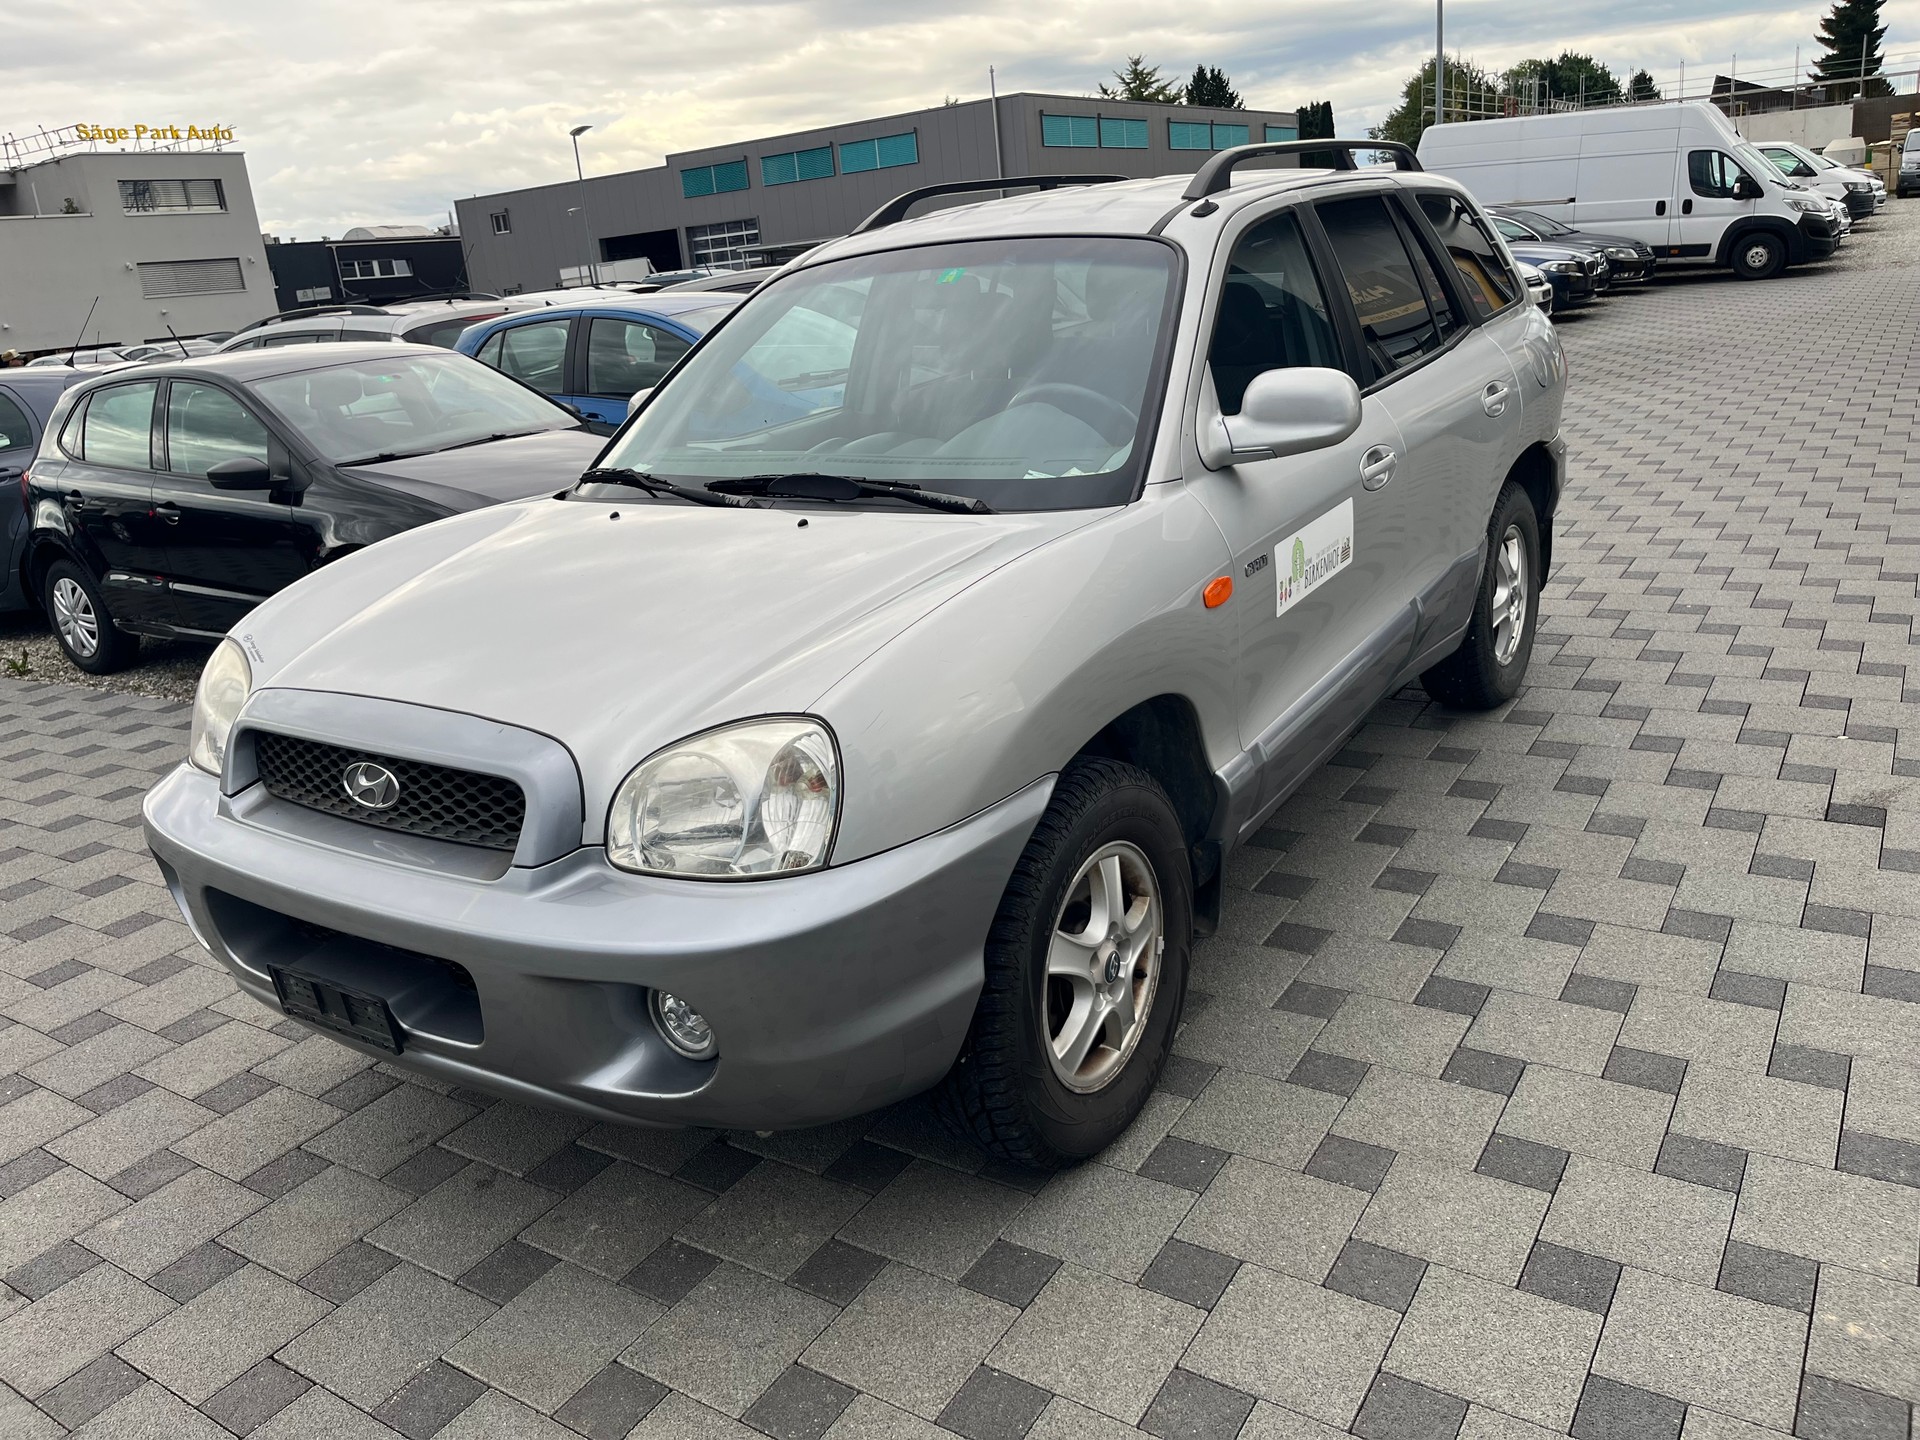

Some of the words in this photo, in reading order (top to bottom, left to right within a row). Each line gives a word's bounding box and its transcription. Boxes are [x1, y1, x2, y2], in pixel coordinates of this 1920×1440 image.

[75, 123, 130, 144] Säge
[134, 123, 182, 141] Park
[187, 123, 234, 141] Auto
[1304, 546, 1340, 589] BIRKENHOF
